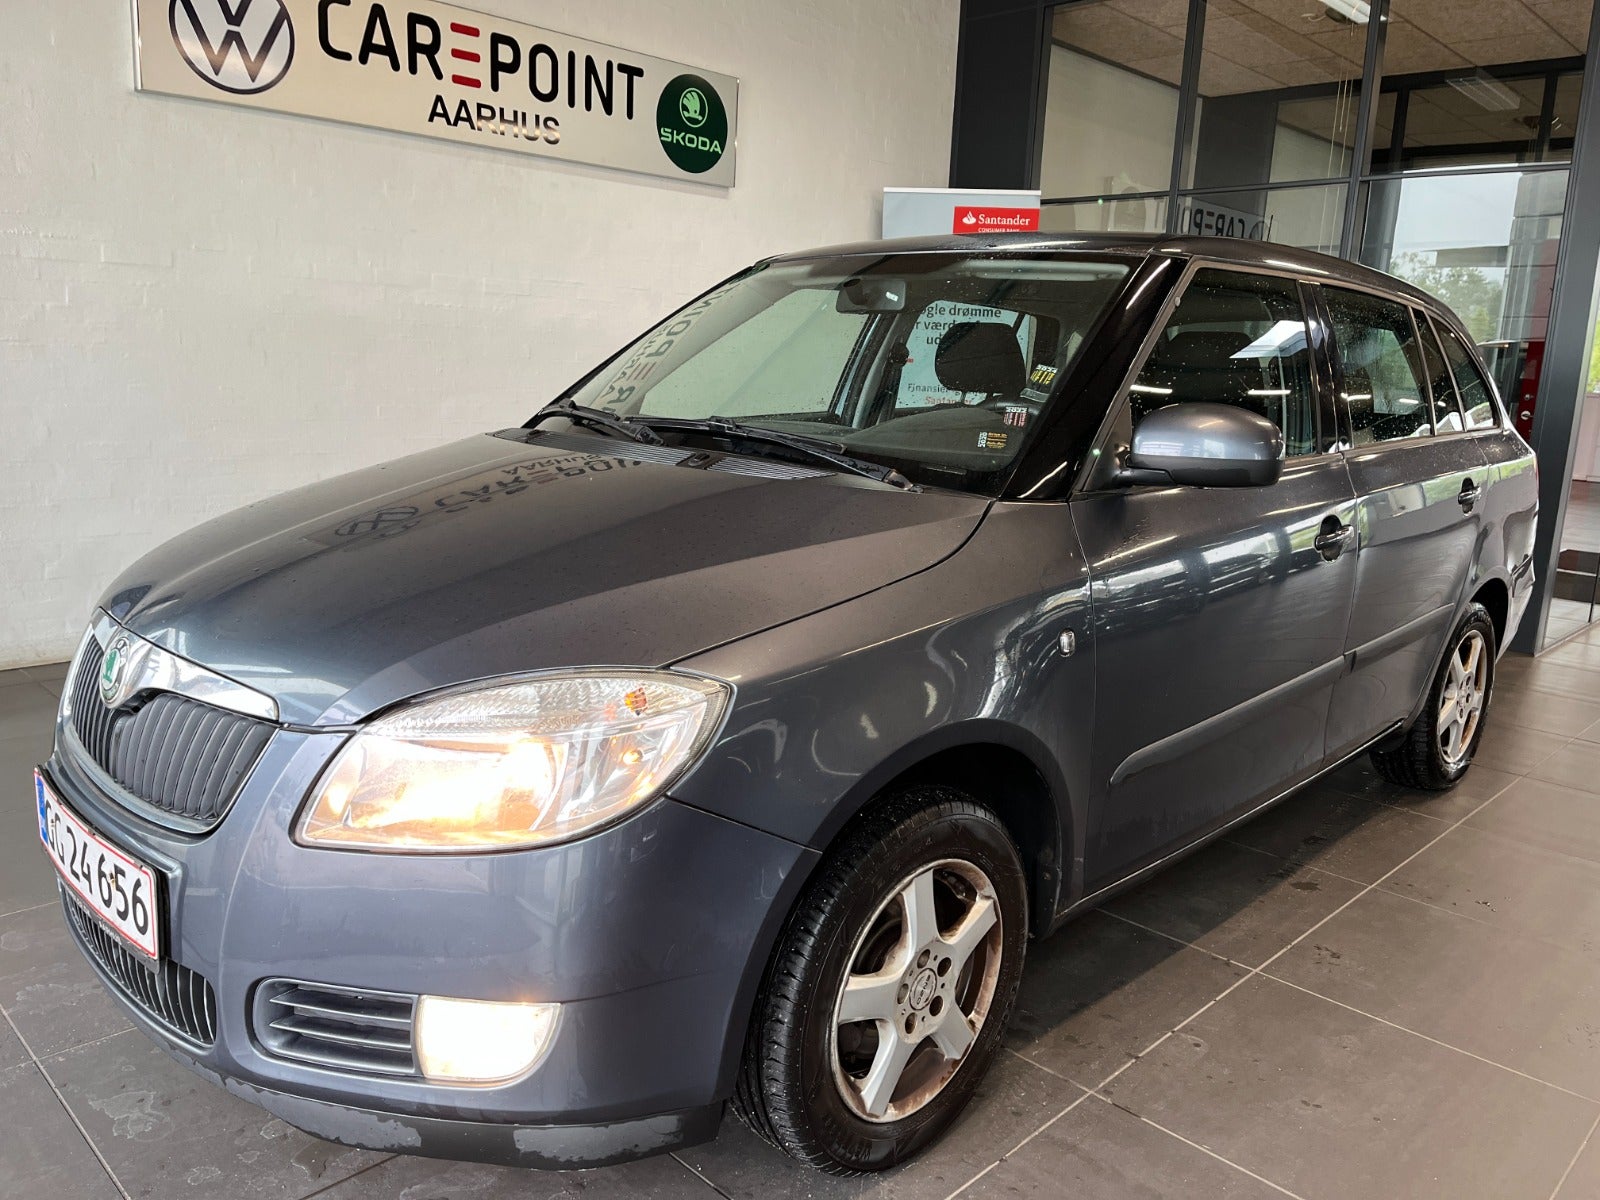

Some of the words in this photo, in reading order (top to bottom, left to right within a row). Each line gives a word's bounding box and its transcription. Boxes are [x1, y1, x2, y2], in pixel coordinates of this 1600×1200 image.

[317, 0, 645, 121] CAREPOINT
[427, 94, 561, 146] AARHUS
[660, 127, 723, 155] SKODA
[977, 213, 1031, 226] Santander
[921, 302, 946, 318] gle
[949, 303, 1002, 318] drømme
[67, 829, 93, 895] 24
[98, 853, 149, 937] 656
